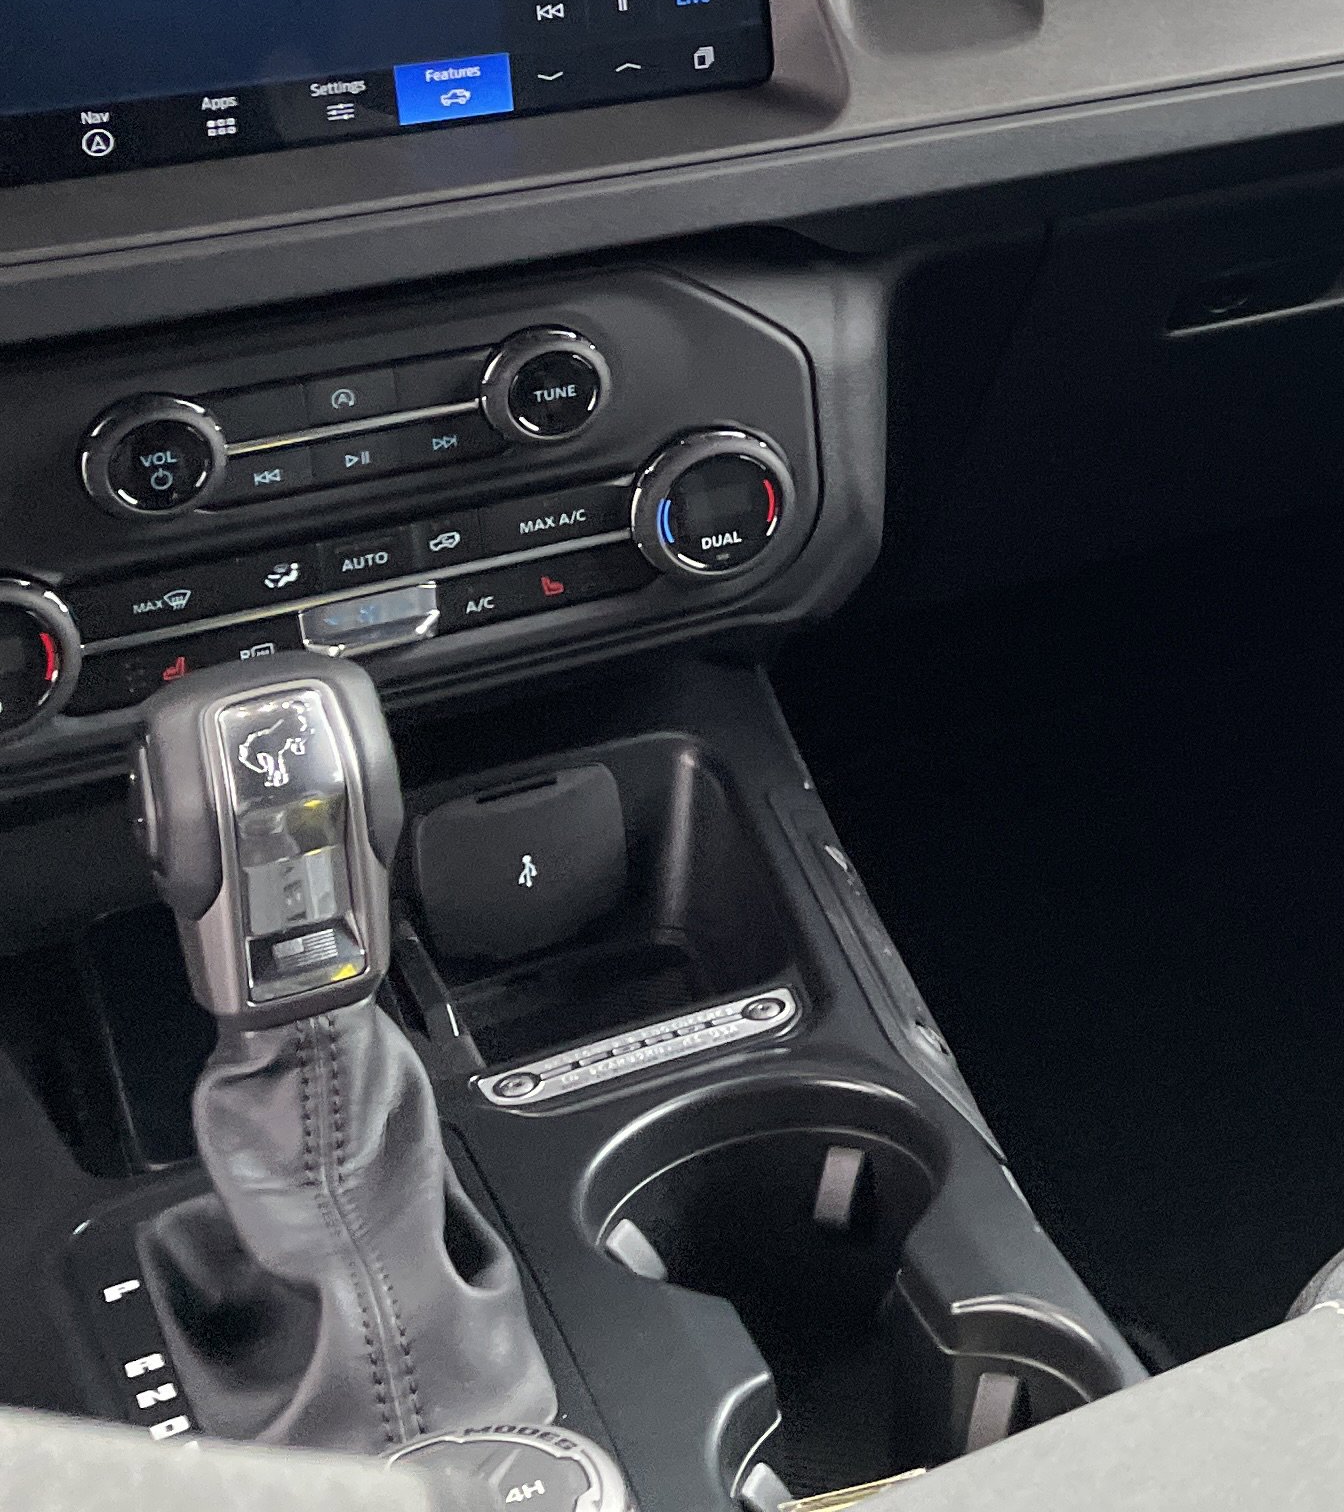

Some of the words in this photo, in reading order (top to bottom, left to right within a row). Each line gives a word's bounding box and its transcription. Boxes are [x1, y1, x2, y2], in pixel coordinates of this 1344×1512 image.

[424, 66, 481, 83] Features
[310, 78, 367, 98] Settings
[201, 96, 238, 111] Apps
[80, 111, 110, 125] Nav
[533, 382, 578, 404] TUNE
[140, 449, 178, 468] VOL
[520, 516, 557, 535] MAX
[559, 508, 588, 527] A/C
[700, 528, 743, 552] DUAL
[341, 551, 389, 573] AUTO
[132, 597, 163, 616] MAX
[465, 596, 495, 615] A/C
[103, 1279, 141, 1303] P
[136, 1383, 178, 1409] N
[463, 1423, 578, 1451] MODES
[505, 1478, 546, 1504] 4H
